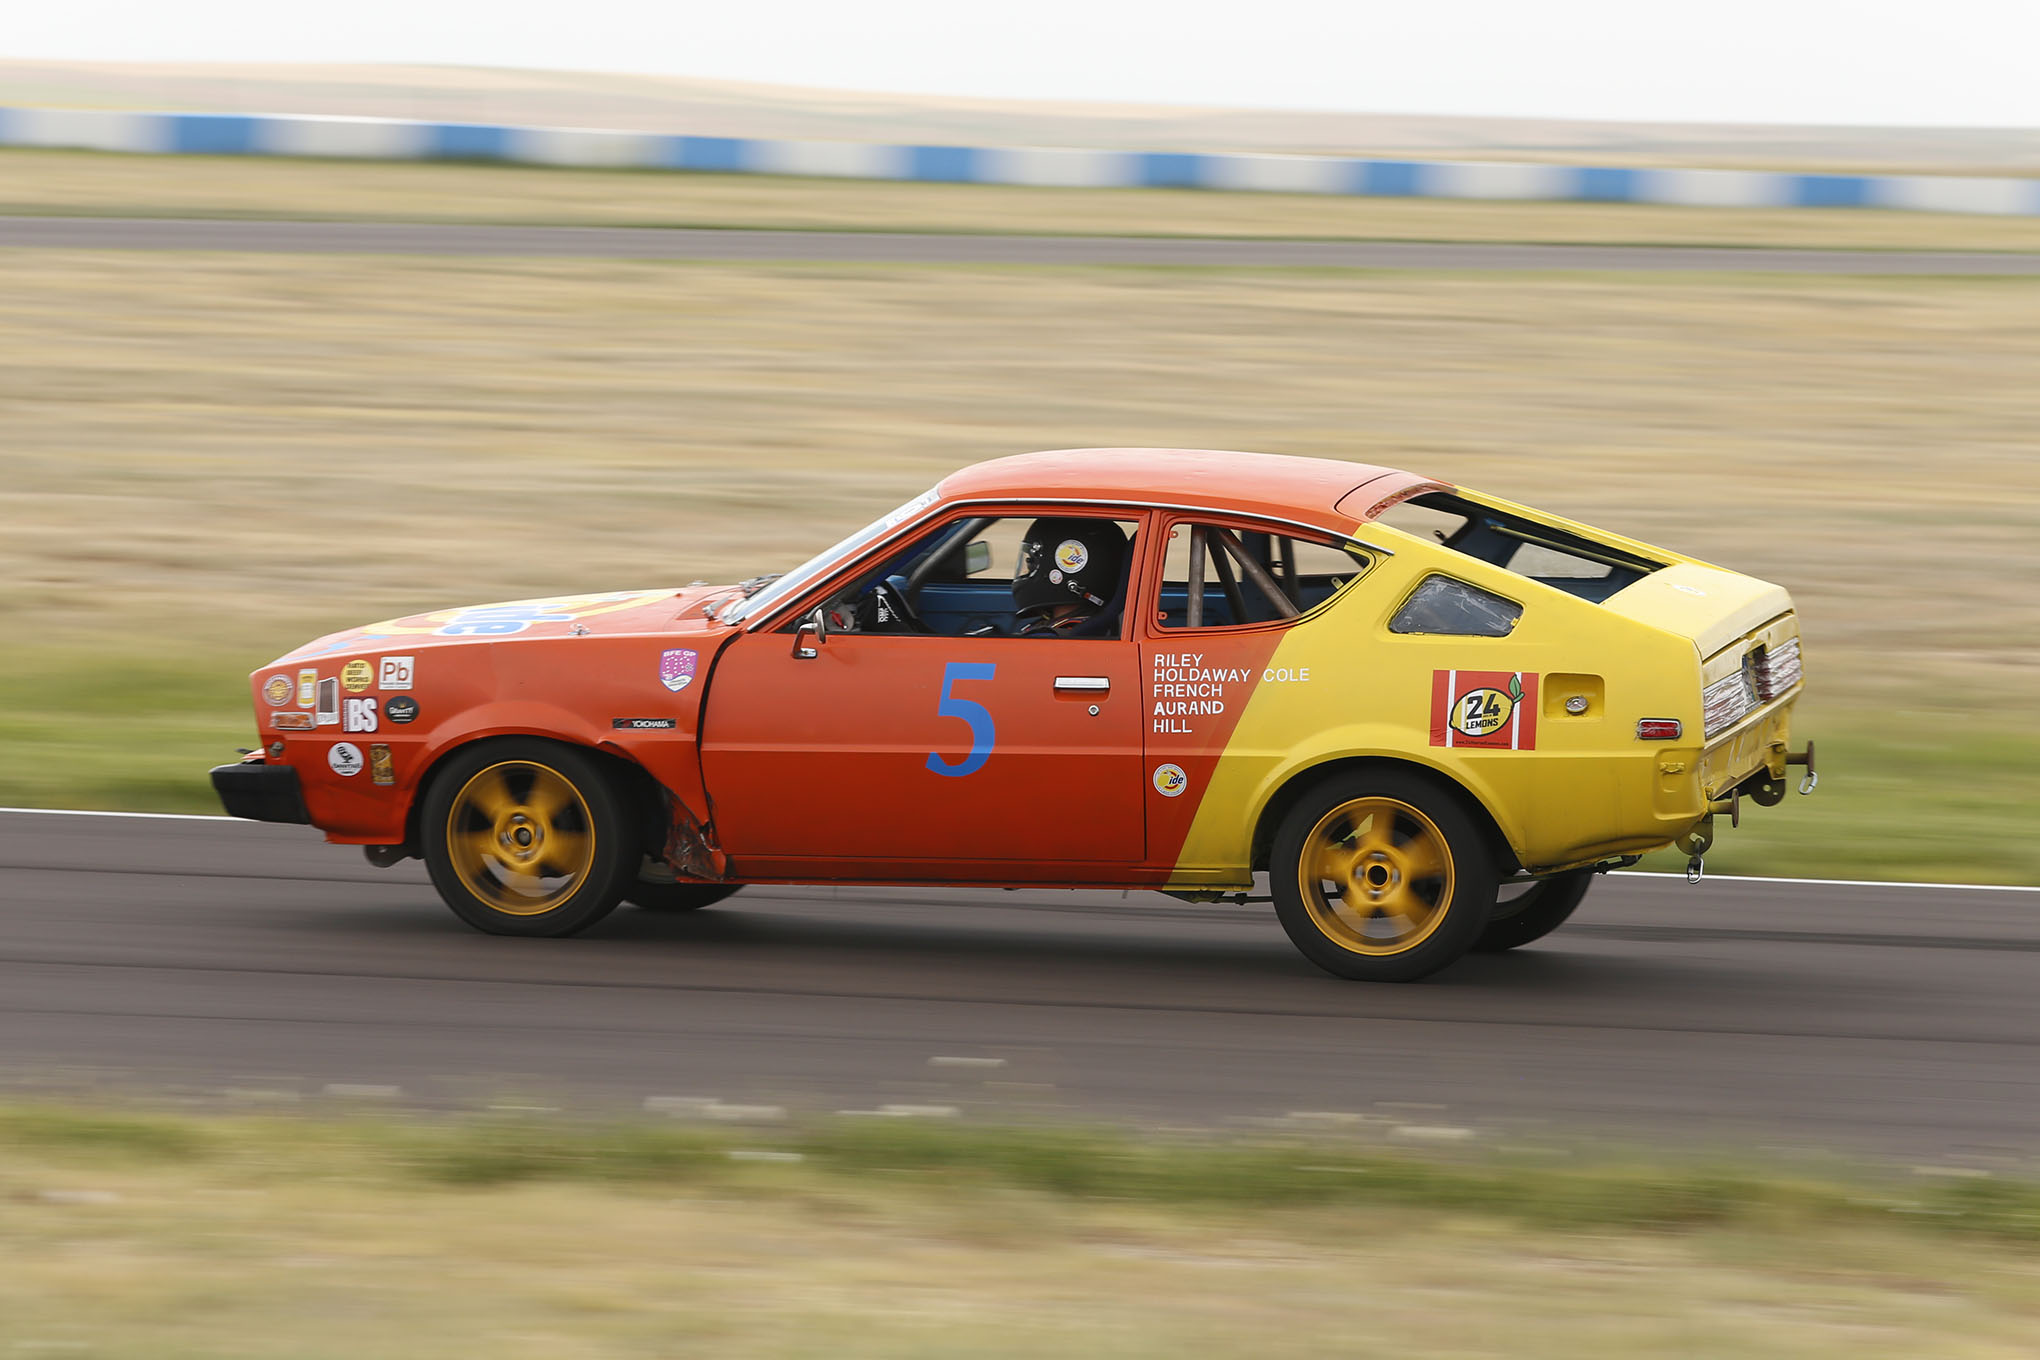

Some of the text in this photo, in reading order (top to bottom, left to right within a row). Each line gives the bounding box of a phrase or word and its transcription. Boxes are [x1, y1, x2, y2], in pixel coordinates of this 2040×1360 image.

[1154, 653, 1204, 667] RILEY
[383, 662, 409, 681] Pb
[1153, 668, 1311, 682] HOLDAWAY COLE
[1153, 683, 1223, 698] FRENCH
[1153, 701, 1225, 716] AURAND
[1466, 693, 1501, 720] 24
[347, 698, 378, 732] BS
[925, 662, 997, 777] 5
[632, 720, 670, 728] YOKOHAMA
[1153, 719, 1193, 734] HILL
[1466, 717, 1499, 730] LEMONS
[1168, 774, 1184, 785] ide
